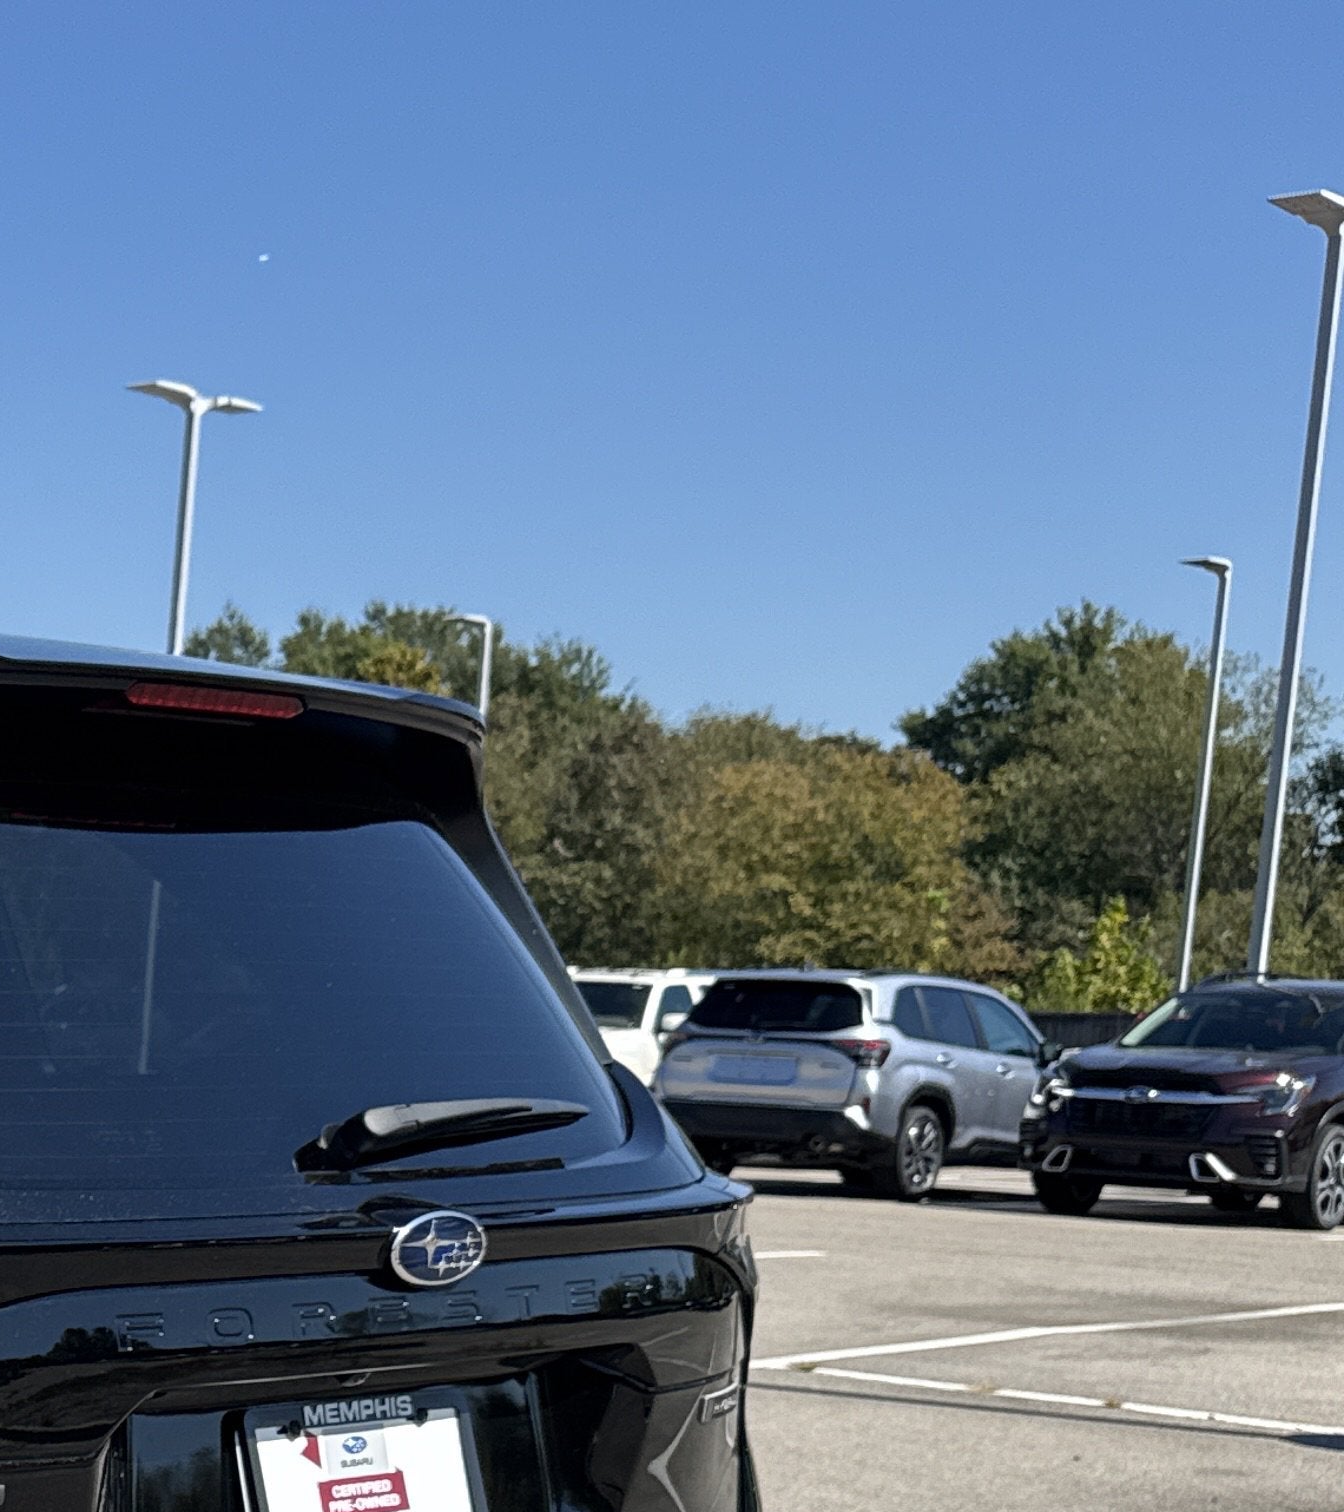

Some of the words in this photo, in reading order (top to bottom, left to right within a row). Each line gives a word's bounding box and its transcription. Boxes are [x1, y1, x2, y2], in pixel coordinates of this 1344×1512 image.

[116, 1272, 654, 1352] FORESTER
[303, 1395, 413, 1426] MEMPHIS
[341, 1457, 373, 1468] SUBARU
[331, 1479, 392, 1498] CERTIFIED
